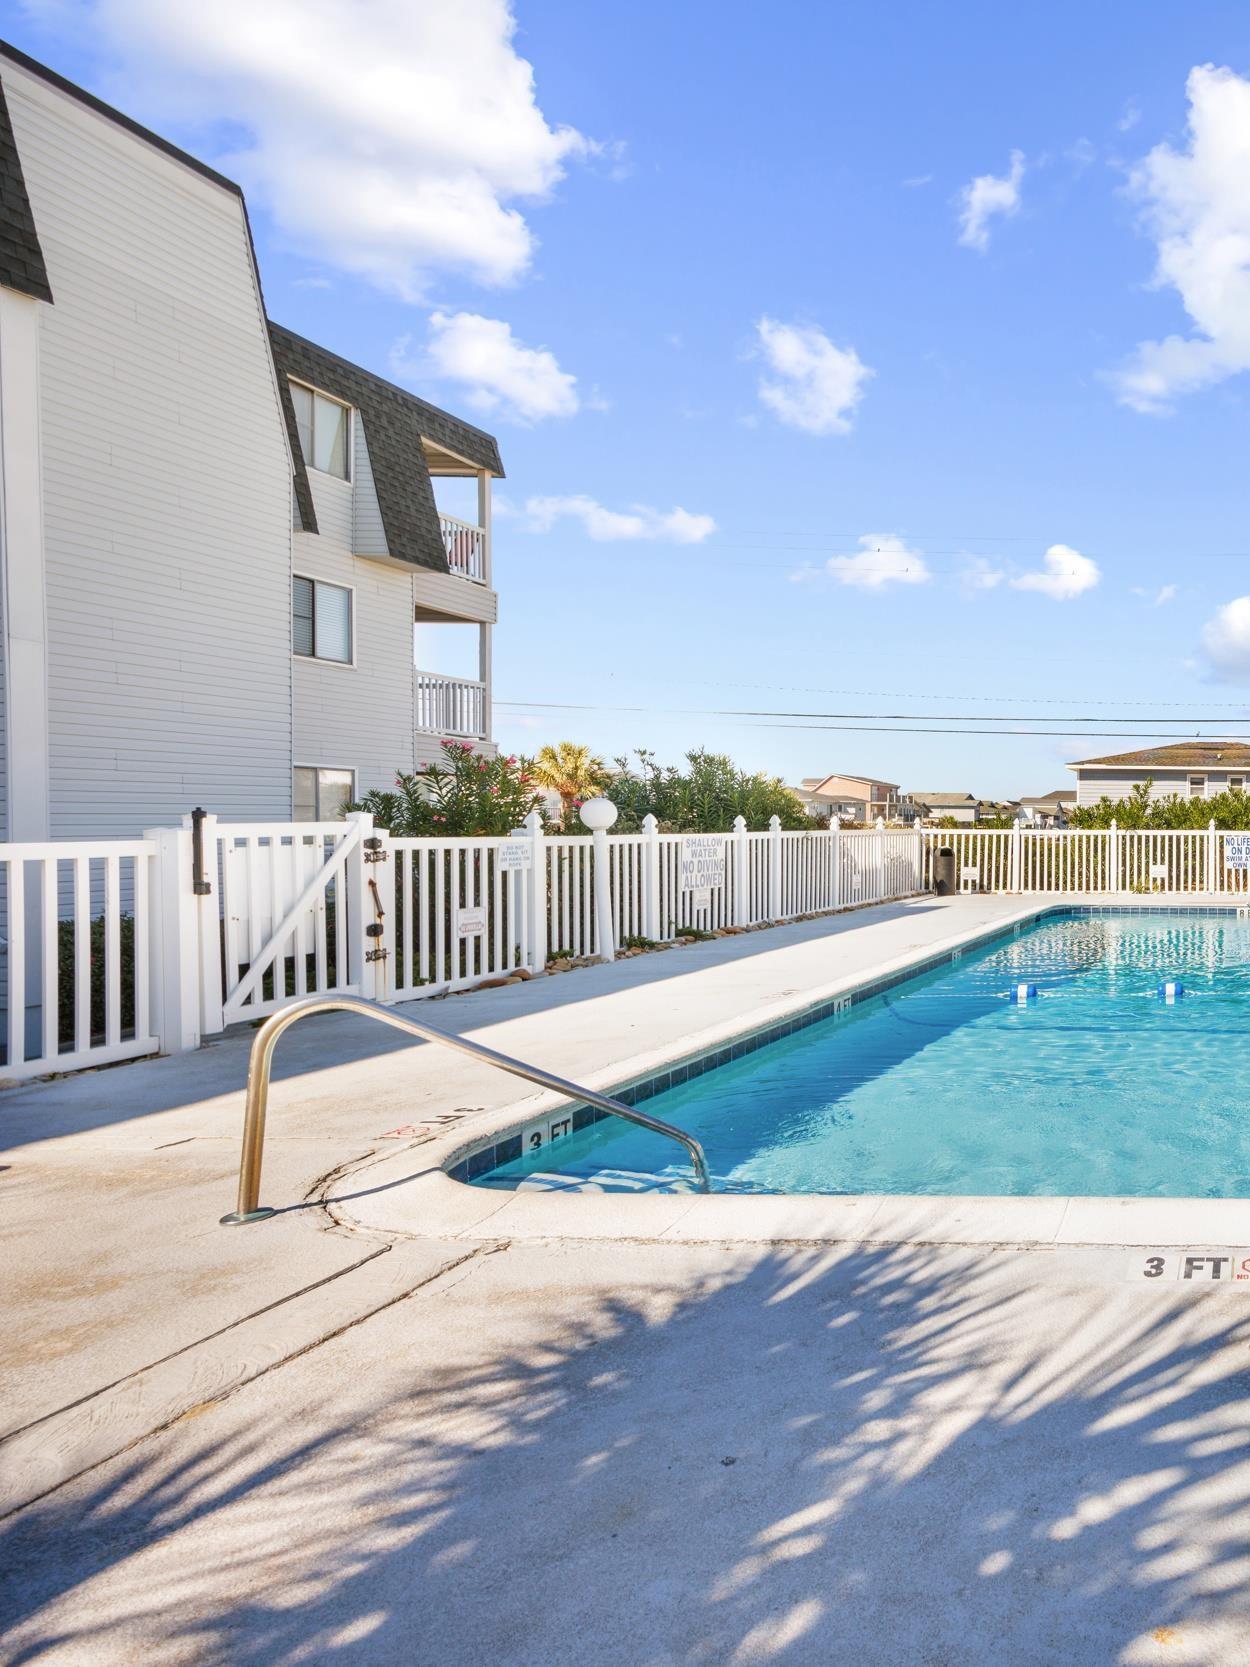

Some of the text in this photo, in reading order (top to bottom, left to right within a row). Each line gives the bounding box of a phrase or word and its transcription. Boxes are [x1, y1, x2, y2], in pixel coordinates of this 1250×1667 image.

[686, 837, 723, 848] SHALLOW
[1226, 838, 1235, 846] NO
[691, 848, 718, 858] WATER
[1231, 847, 1243, 855] ON
[683, 859, 725, 874] NO DIVING
[684, 873, 724, 889] ALLOWED
[530, 1118, 571, 1151] 3 FT
[1143, 1256, 1229, 1279] 3 FT
